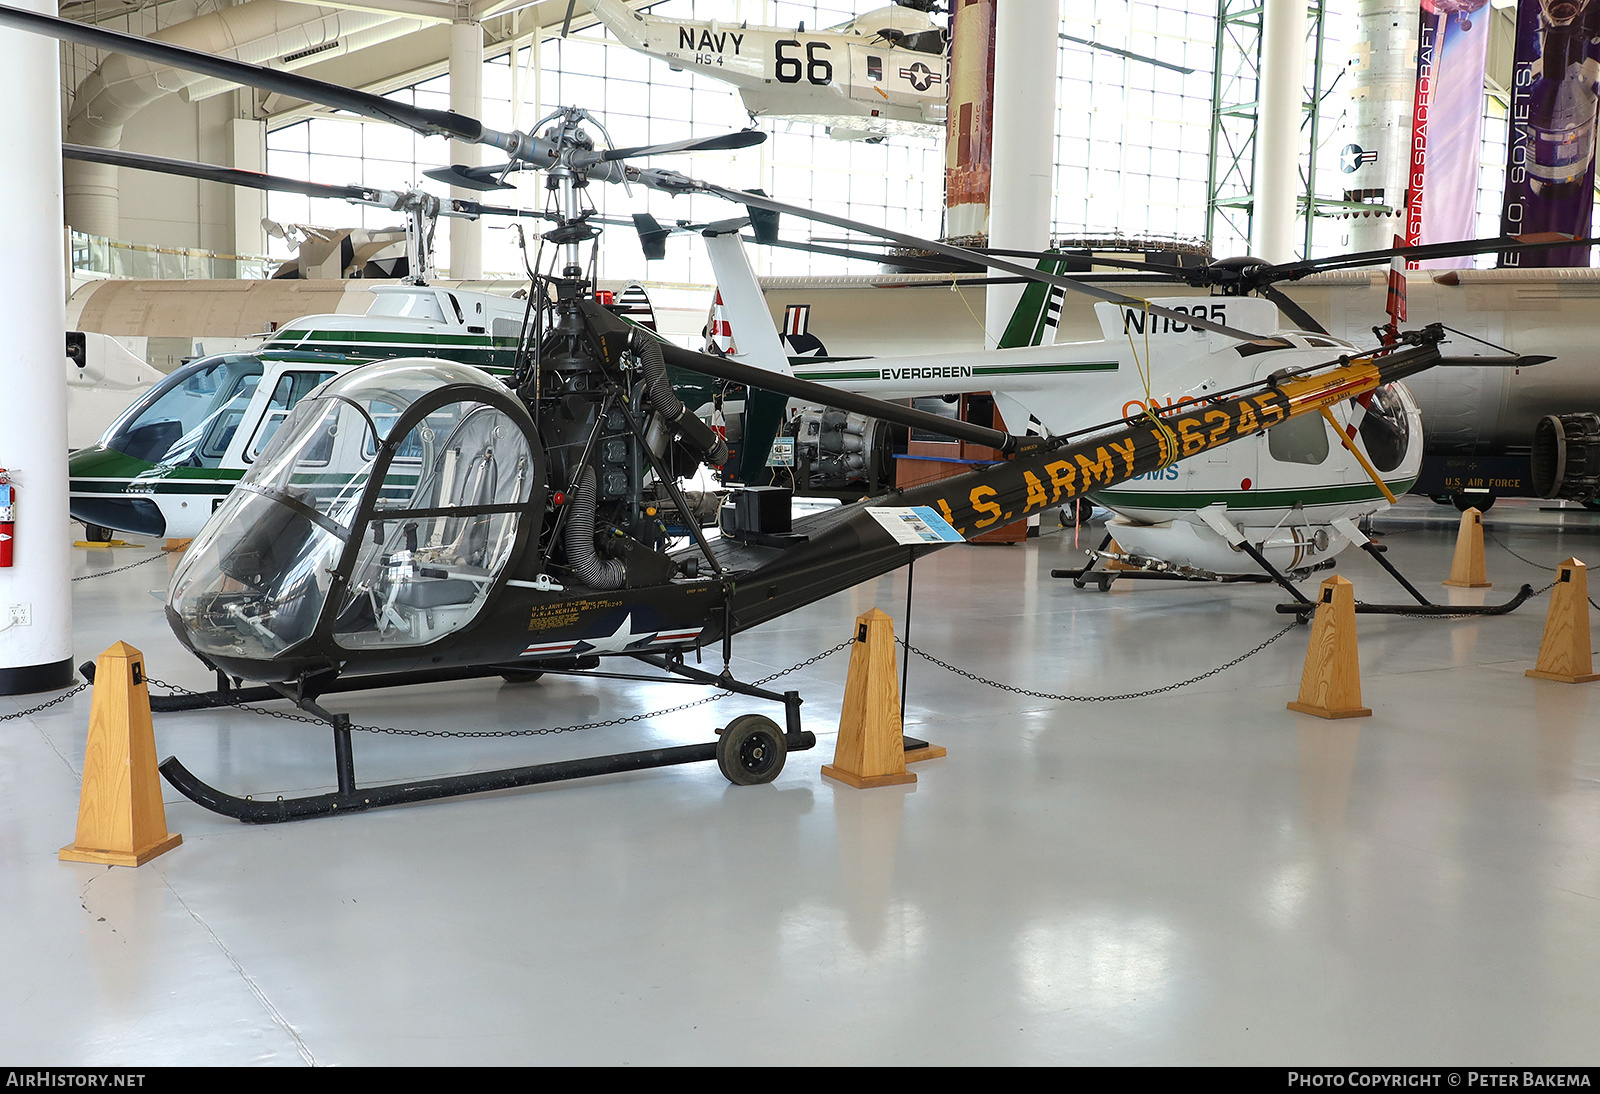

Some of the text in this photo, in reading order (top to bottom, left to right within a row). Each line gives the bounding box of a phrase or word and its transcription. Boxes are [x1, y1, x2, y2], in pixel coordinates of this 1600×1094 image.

[679, 26, 744, 55] NAVY
[774, 39, 833, 86] 66
[1415, 22, 1434, 165] SPACECRAFT
[1503, 61, 1533, 267] ELO, SOVIETS!
[881, 365, 971, 380] EVERGREEN
[1022, 438, 1135, 514] ARMY
[1467, 478, 1483, 487] AIR
[1489, 479, 1520, 488] FORCE
